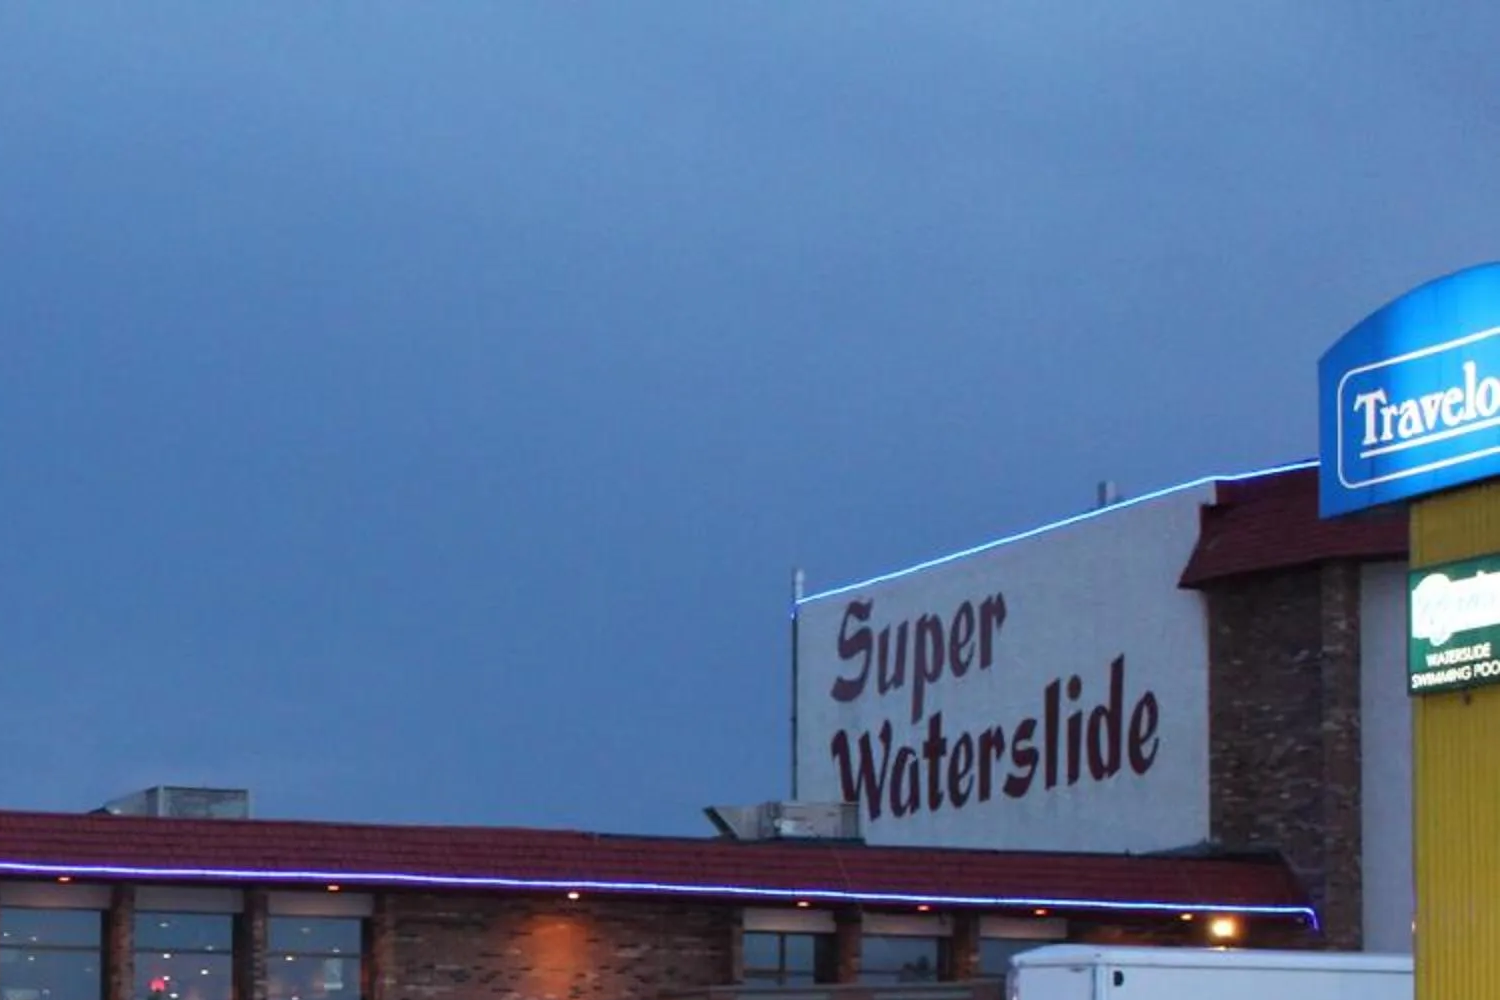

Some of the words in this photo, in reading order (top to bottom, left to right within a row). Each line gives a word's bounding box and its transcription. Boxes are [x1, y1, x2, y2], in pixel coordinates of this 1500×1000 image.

[830, 591, 1008, 725] Super
[1411, 665, 1473, 689] SWIMMING
[1425, 641, 1492, 668] WATERSLIDE
[831, 653, 1160, 822] Waterslide
